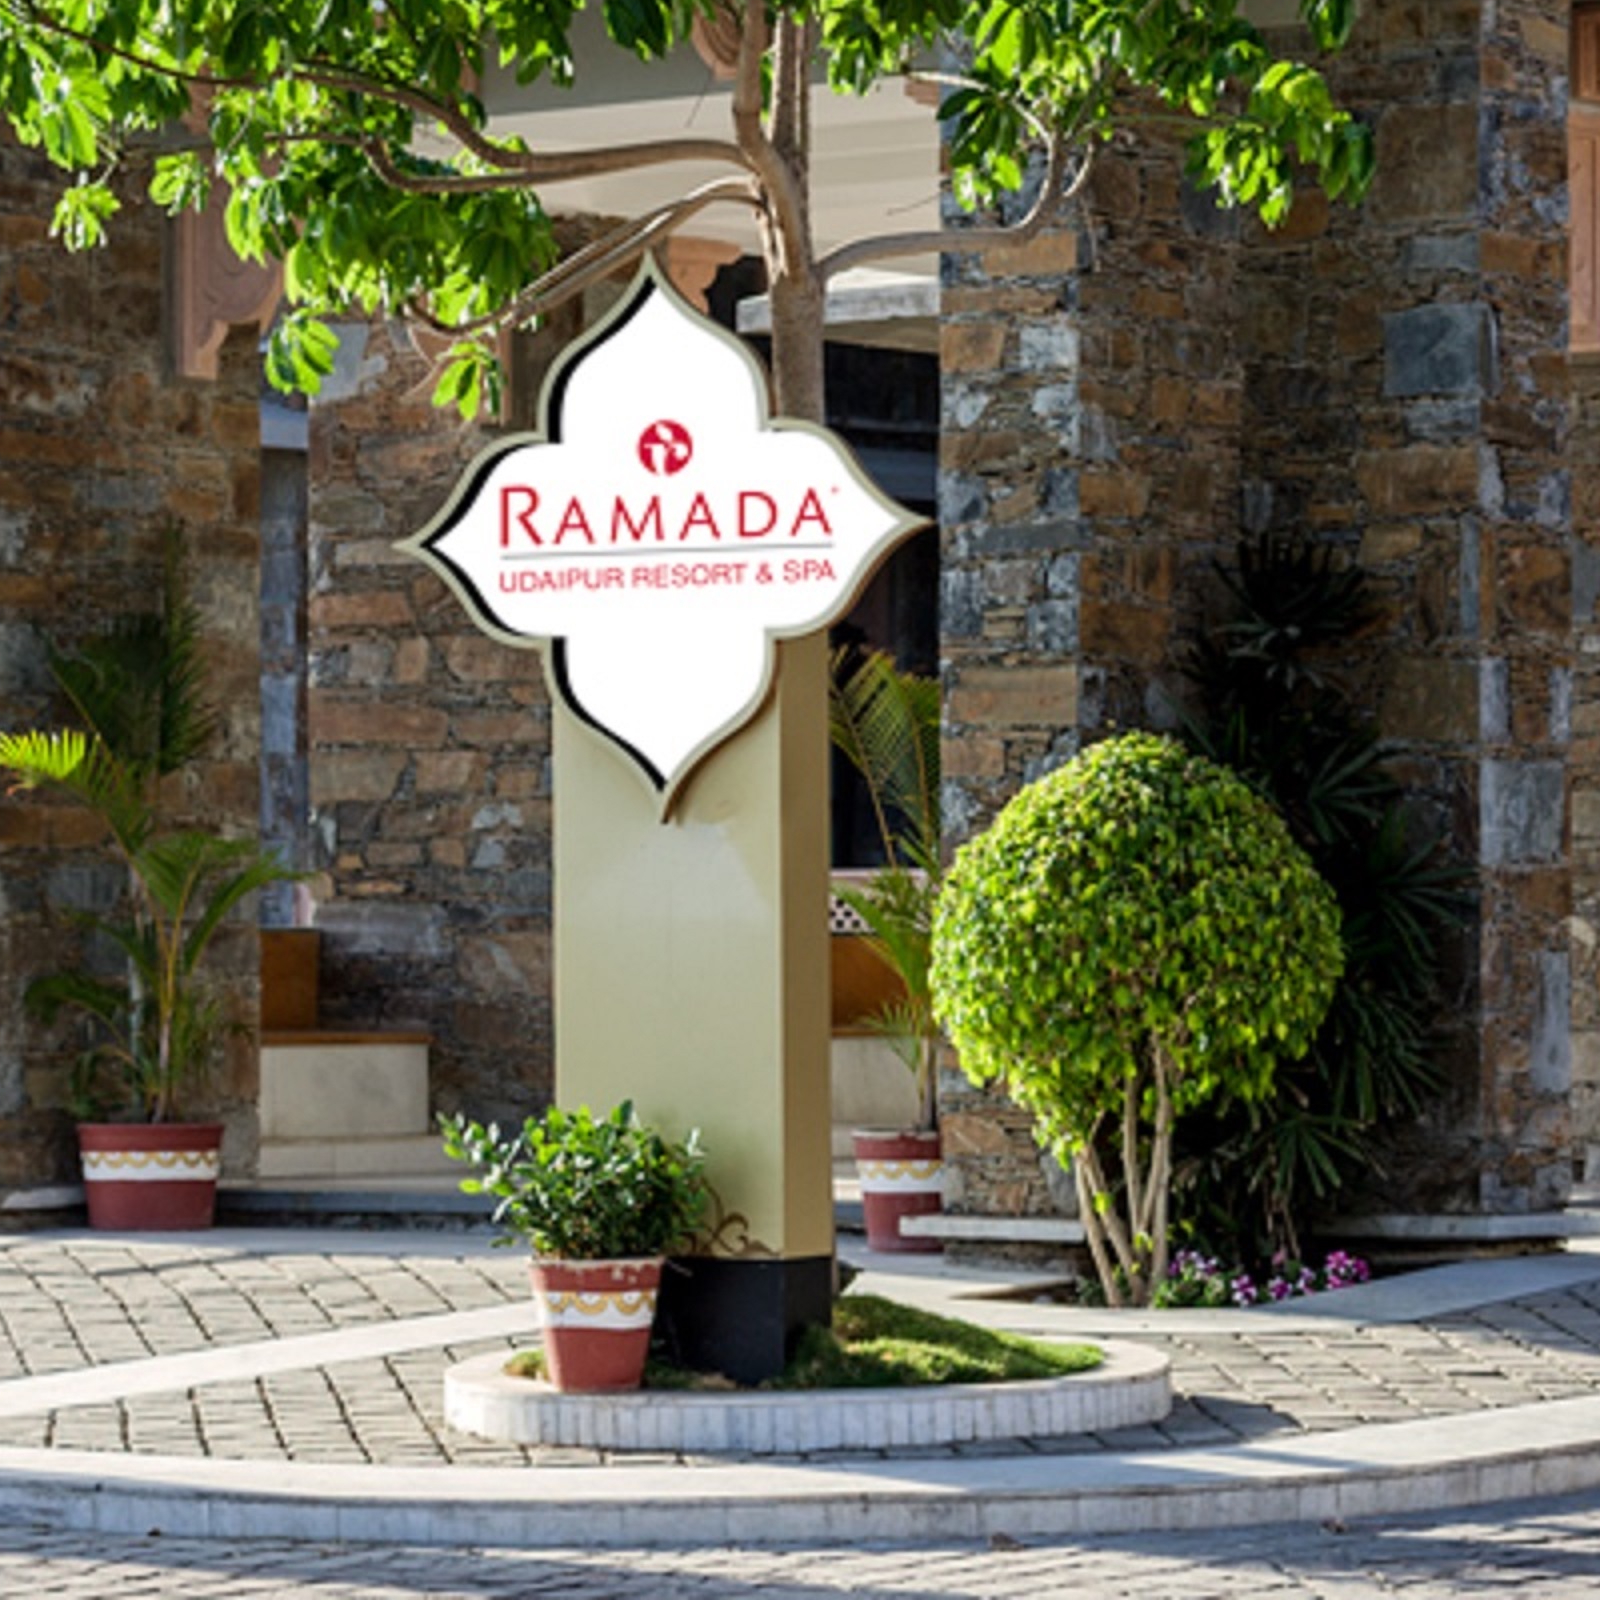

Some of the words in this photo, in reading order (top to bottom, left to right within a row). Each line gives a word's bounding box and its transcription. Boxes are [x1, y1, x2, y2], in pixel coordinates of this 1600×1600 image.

[500, 485, 833, 548] RAMADA
[499, 567, 625, 593] UDAIPUR
[631, 563, 748, 589] RESORT
[755, 562, 774, 584] &
[783, 558, 837, 583] SPA
